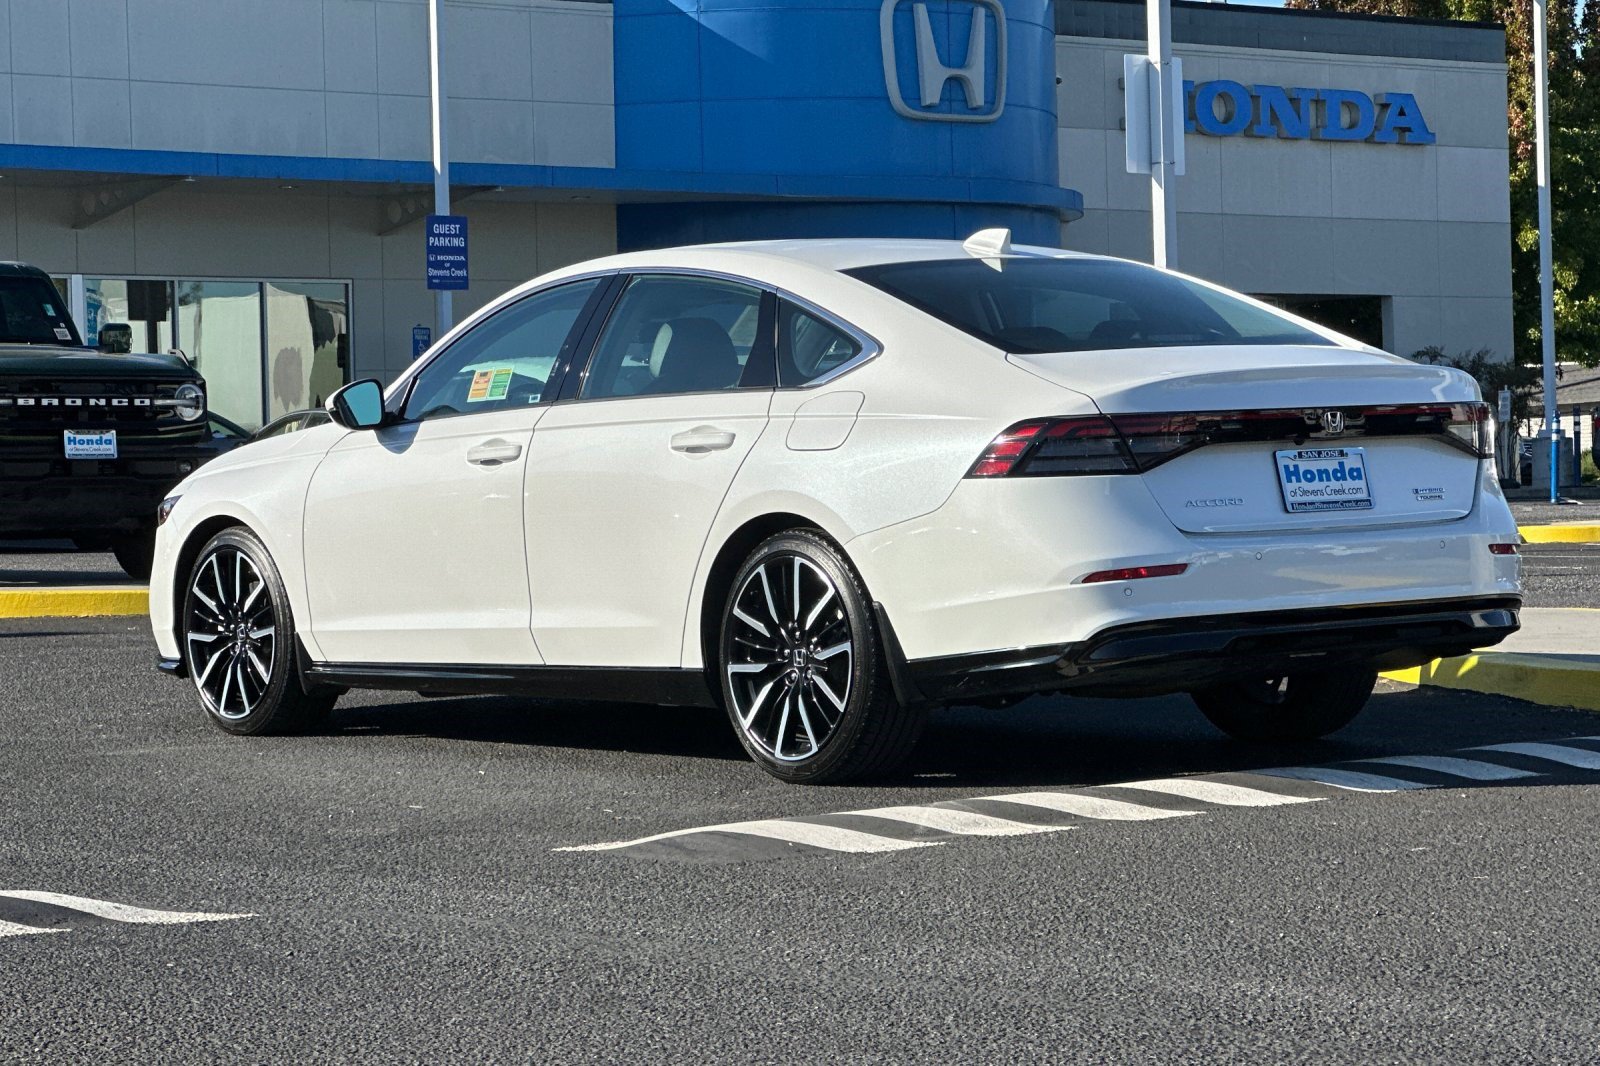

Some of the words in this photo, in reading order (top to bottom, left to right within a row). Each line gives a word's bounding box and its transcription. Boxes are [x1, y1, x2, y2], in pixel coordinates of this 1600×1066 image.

[1183, 79, 1437, 145] ONDA
[433, 223, 460, 235] GUEST
[429, 236, 465, 247] PARKING
[428, 267, 450, 277] Stevens
[450, 267, 467, 277] Creek
[17, 398, 151, 406] BRONCO
[67, 435, 113, 446] Honda
[1301, 451, 1319, 459] SAN
[1320, 450, 1342, 458] JOSE
[1283, 461, 1363, 484] Honda
[1290, 487, 1298, 498] of
[1185, 498, 1245, 508] ACCORD
